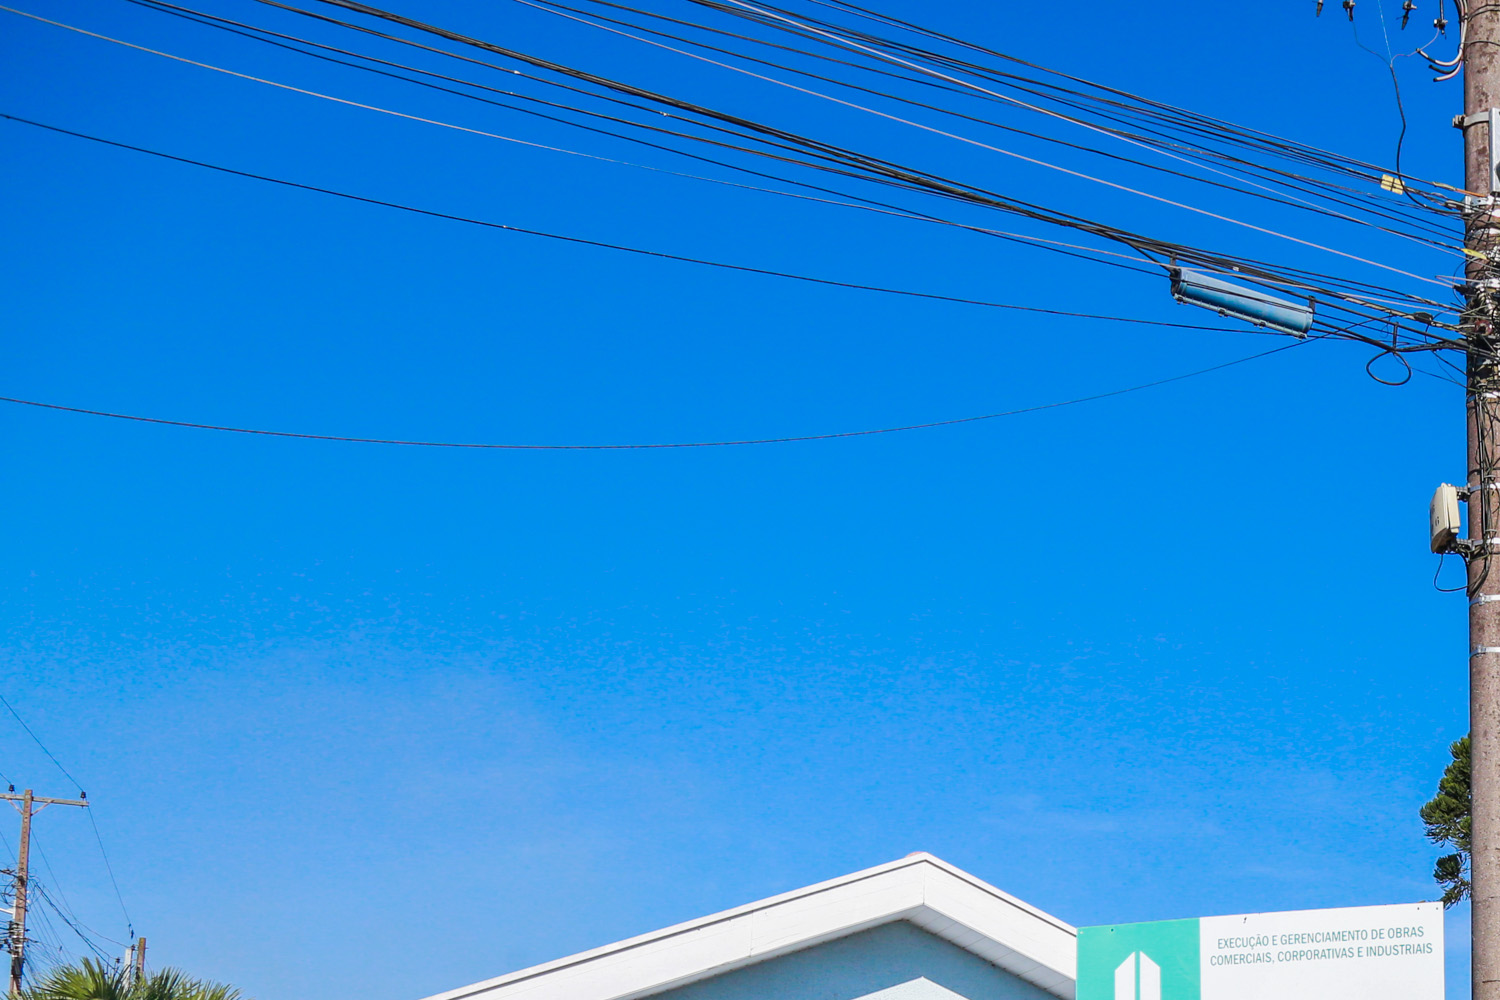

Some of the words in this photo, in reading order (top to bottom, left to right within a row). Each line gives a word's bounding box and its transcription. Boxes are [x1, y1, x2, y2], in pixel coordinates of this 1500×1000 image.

[1217, 933, 1269, 951] EXECUÇÃO
[1272, 934, 1278, 946] E
[1280, 929, 1368, 946] GERENCIAMENTO
[1371, 928, 1385, 940] DE
[1387, 925, 1425, 939] OBRAS
[1210, 952, 1275, 966] COMERCIAIS,
[1277, 946, 1354, 962] CORPORATIVAS
[1357, 946, 1364, 958] E
[1366, 942, 1433, 957] INDUSTRIAIS
